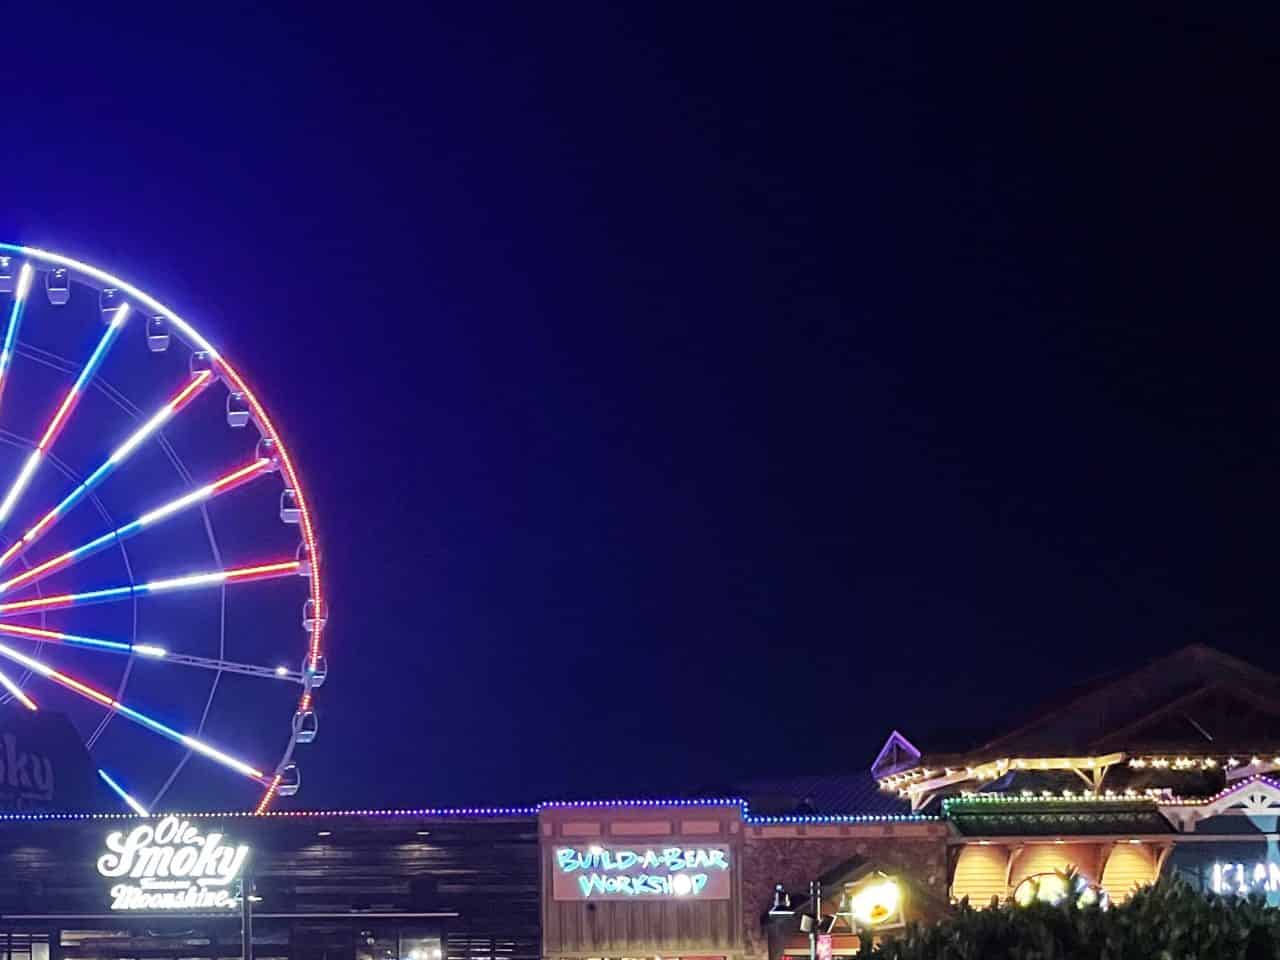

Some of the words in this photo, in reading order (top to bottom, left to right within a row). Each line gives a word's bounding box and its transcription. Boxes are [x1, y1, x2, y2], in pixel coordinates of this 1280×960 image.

[154, 816, 205, 846] Ole
[97, 825, 249, 886] Smoky
[578, 873, 708, 897] WORKSHOP
